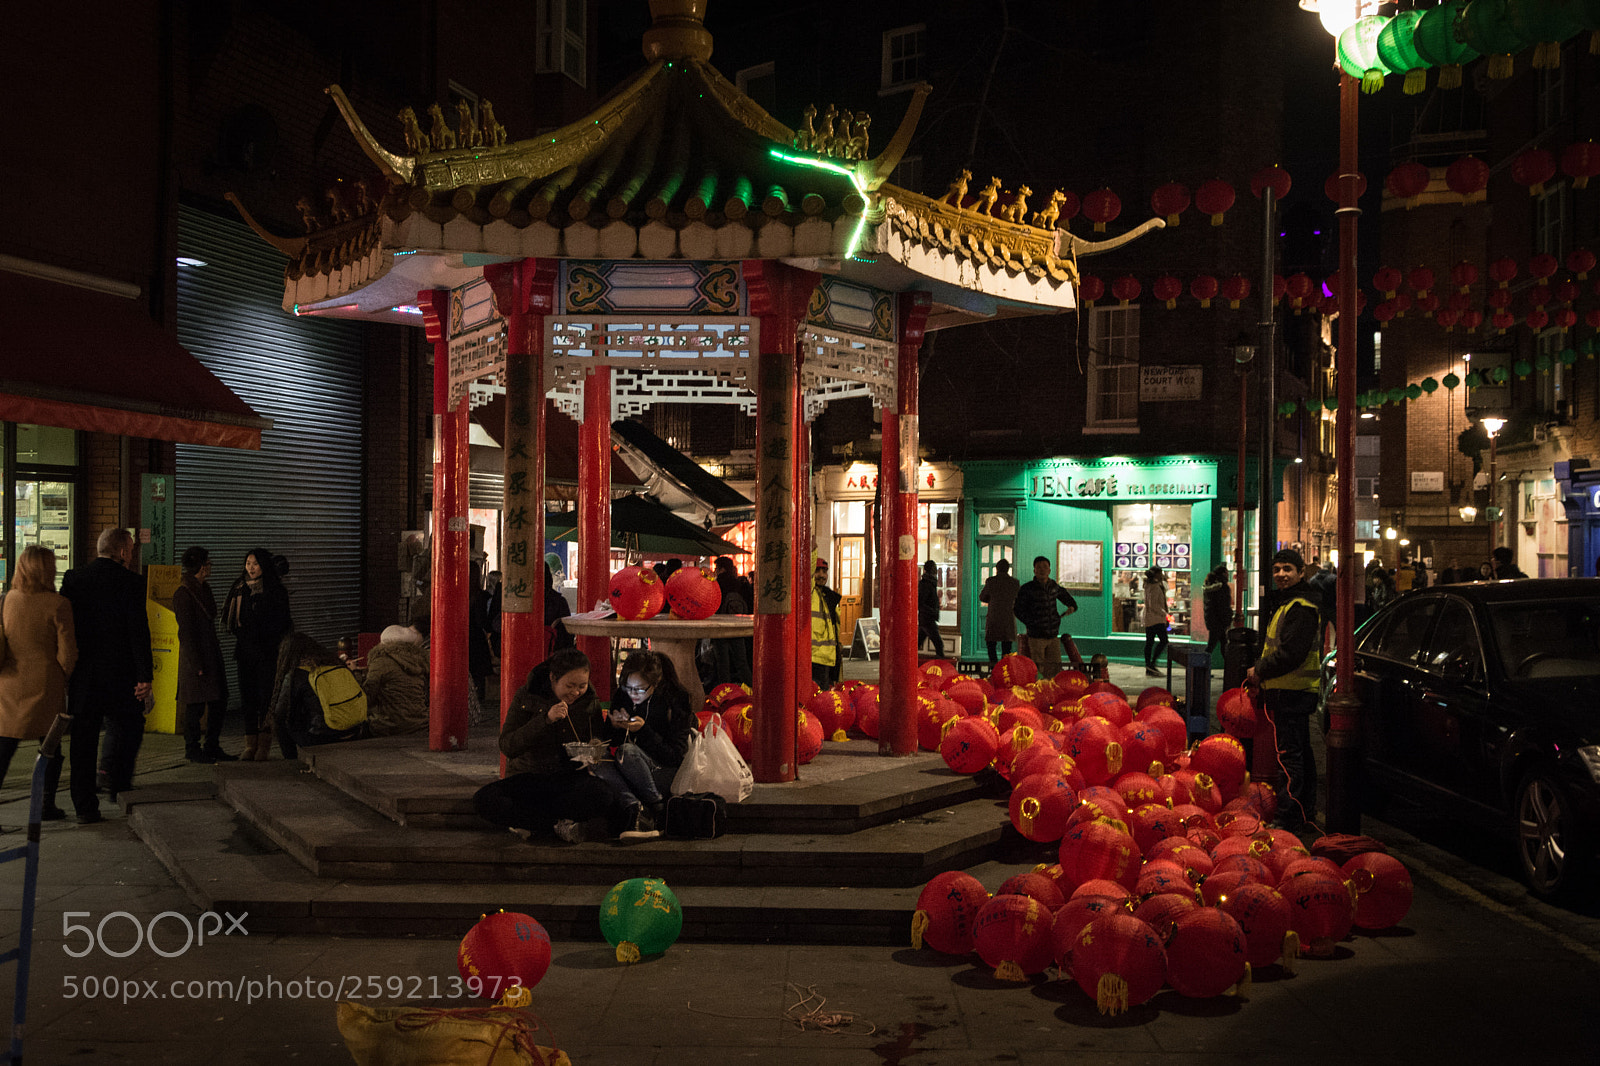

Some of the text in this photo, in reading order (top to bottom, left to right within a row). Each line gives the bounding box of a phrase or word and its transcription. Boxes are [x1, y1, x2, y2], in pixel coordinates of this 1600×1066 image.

[1143, 376, 1172, 385] COURT
[1029, 476, 1073, 498] JEN
[1126, 484, 1146, 495] TEA
[1149, 482, 1212, 495] SPECIALIST
